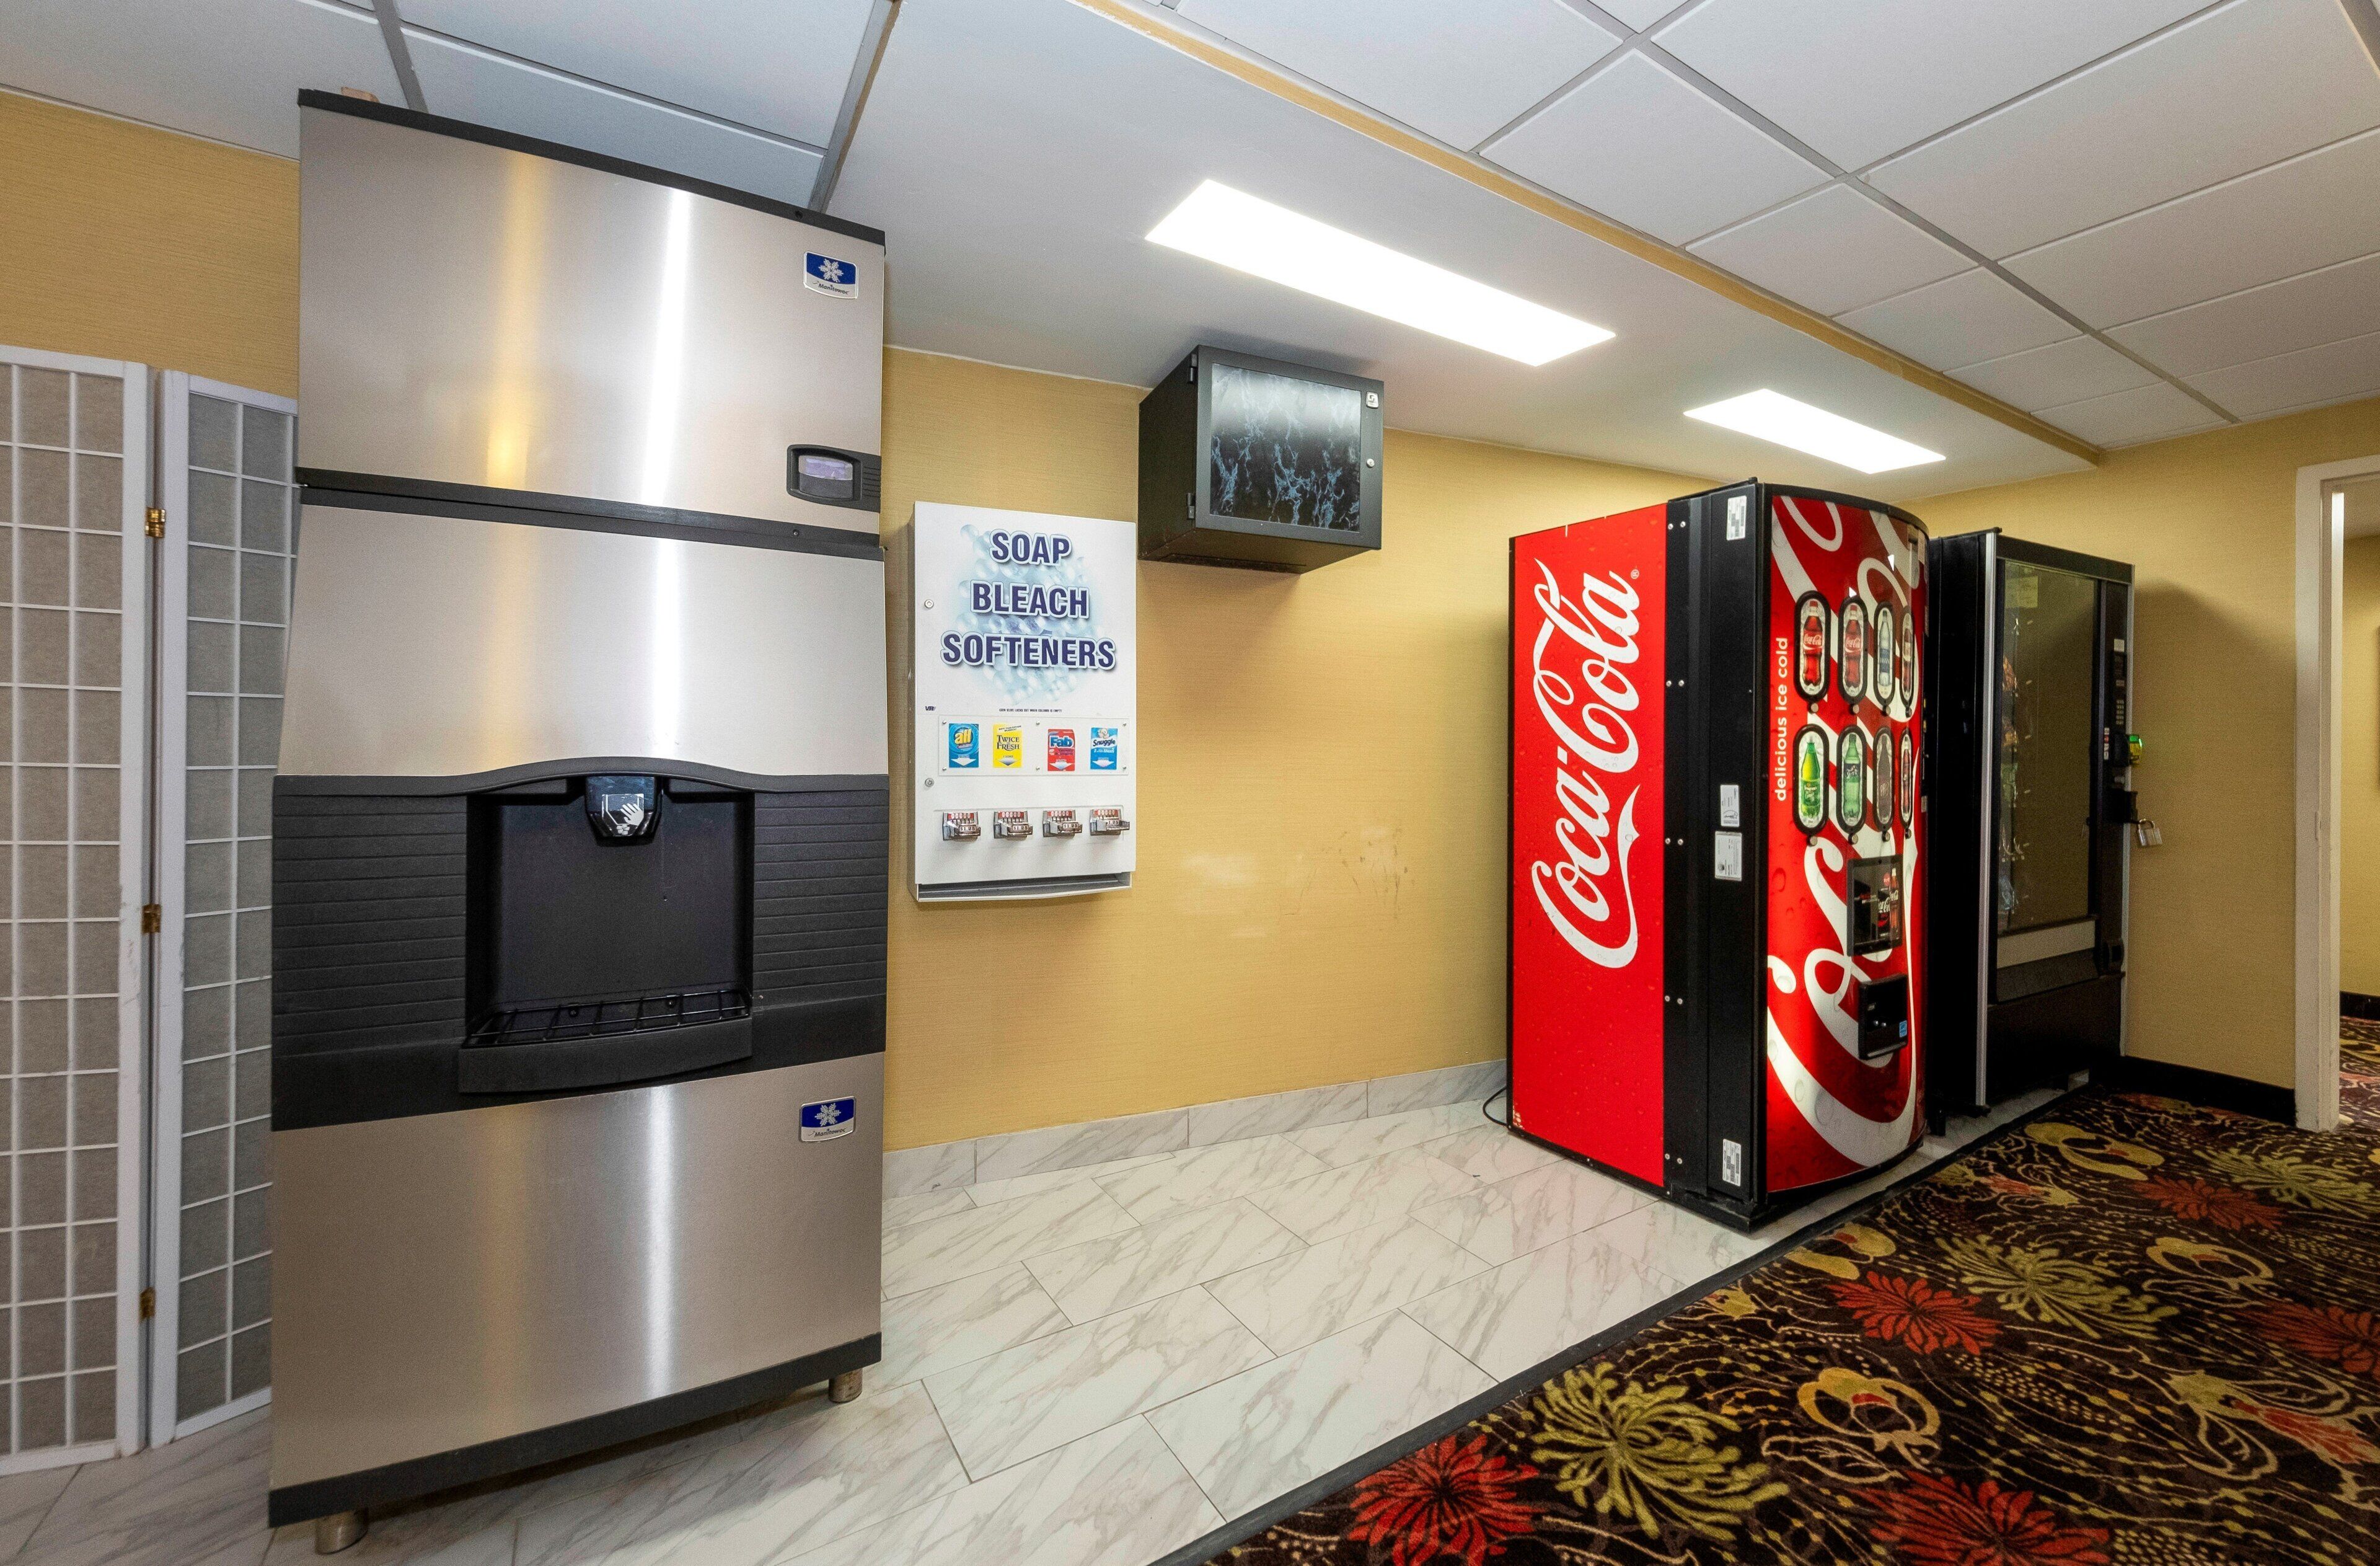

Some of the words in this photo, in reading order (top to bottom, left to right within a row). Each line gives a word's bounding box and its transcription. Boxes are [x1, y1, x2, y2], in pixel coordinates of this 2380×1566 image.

[818, 283, 850, 295] Manitowoc
[991, 531, 1071, 565] SOAP
[971, 582, 1089, 618] BLEACH
[941, 632, 1116, 669] SOFTENERS
[1775, 637, 1788, 678] cold
[1775, 684, 1787, 710] ice
[954, 728, 972, 745] all
[996, 735, 1020, 743] TWICE
[996, 742, 1020, 751] FRESH
[1050, 736, 1073, 748] Fab
[1092, 739, 1116, 747] Snuggle
[1532, 557, 1641, 968] Coca-Cola
[1774, 717, 1787, 802] delicious
[814, 1128, 847, 1138] Manitowoc
